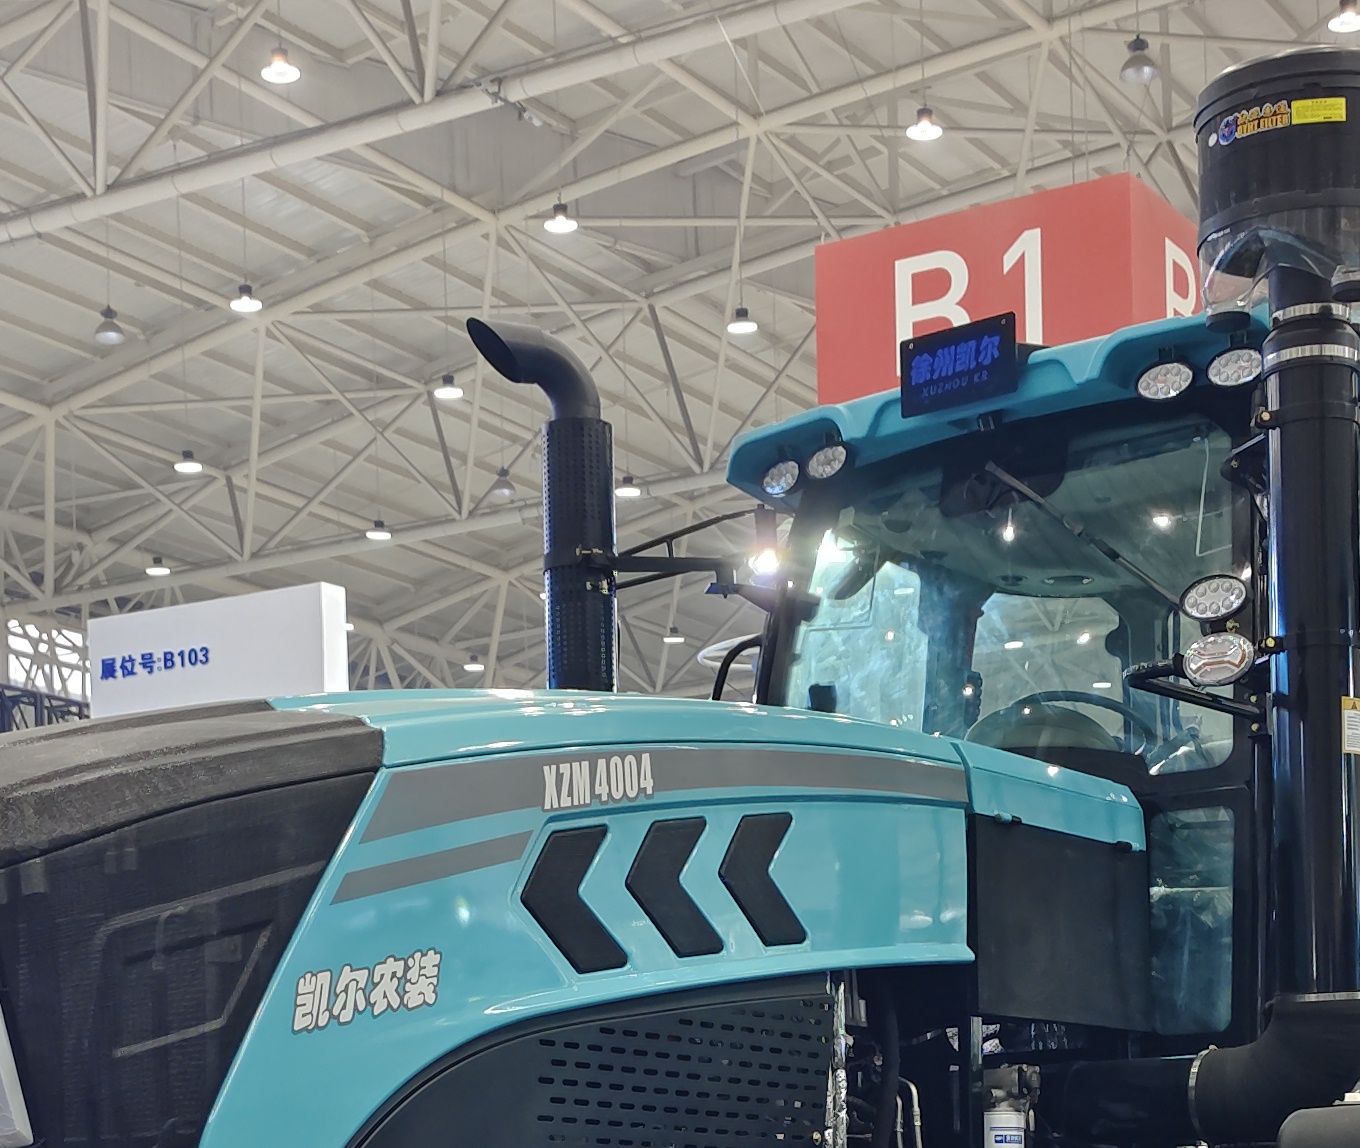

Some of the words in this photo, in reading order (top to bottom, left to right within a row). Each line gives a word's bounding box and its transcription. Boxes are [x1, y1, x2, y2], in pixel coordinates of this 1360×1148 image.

[910, 335, 1000, 386] 徐州凯尔
[922, 375, 968, 397] XUZHOU
[543, 760, 591, 810] XZM
[594, 752, 654, 802] 4004
[293, 948, 441, 1033] 凯尔农装
